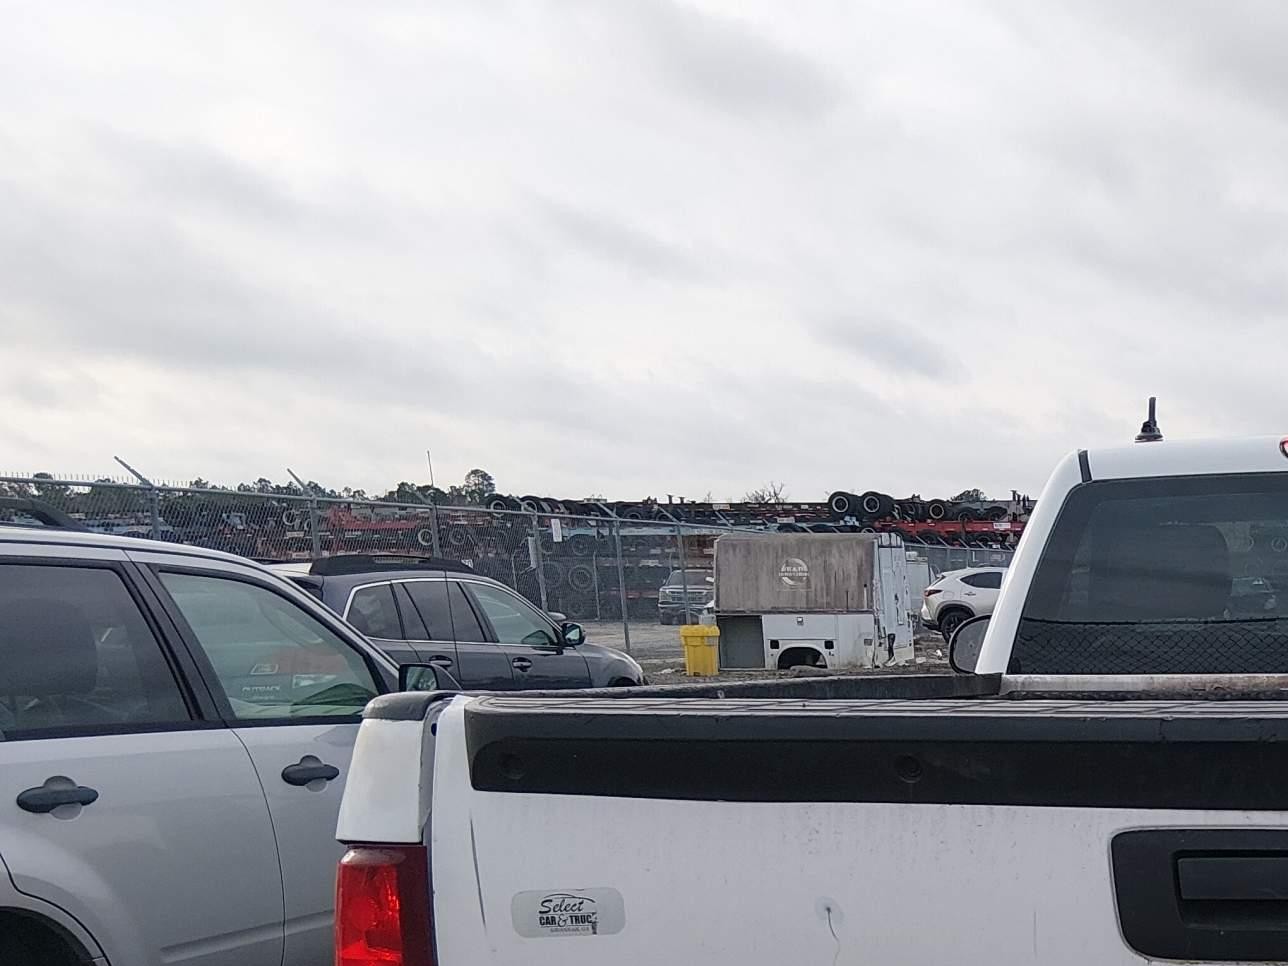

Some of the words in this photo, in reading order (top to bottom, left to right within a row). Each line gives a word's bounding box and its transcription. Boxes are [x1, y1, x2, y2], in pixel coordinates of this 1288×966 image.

[539, 898, 584, 914] Select
[539, 915, 557, 926] CAR
[558, 914, 568, 927] &
[569, 914, 596, 925] TRUC
